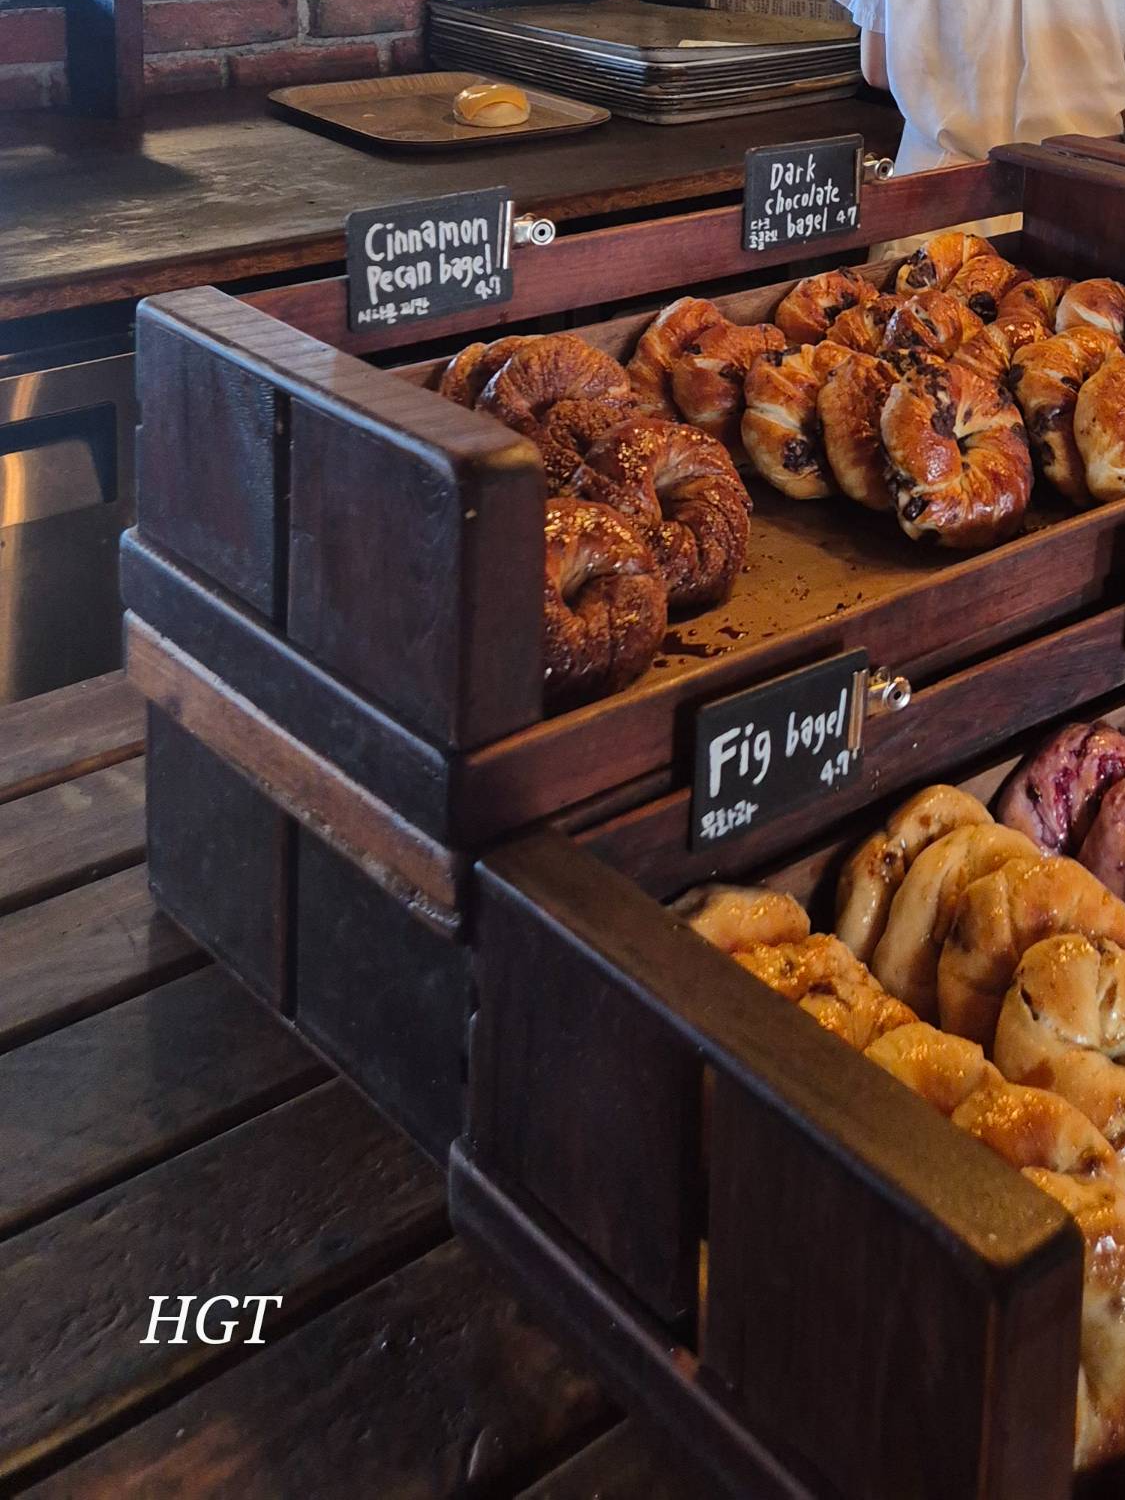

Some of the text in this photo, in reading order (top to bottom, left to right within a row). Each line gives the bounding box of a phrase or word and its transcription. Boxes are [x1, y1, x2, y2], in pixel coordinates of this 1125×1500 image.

[770, 153, 817, 191] Dark
[765, 178, 841, 215] chocolate
[364, 217, 488, 261] Cinnamon
[787, 207, 828, 238] bagel
[366, 243, 492, 305] Pecan bagel
[709, 687, 848, 798] Fig bagel
[819, 750, 850, 787] 4.7
